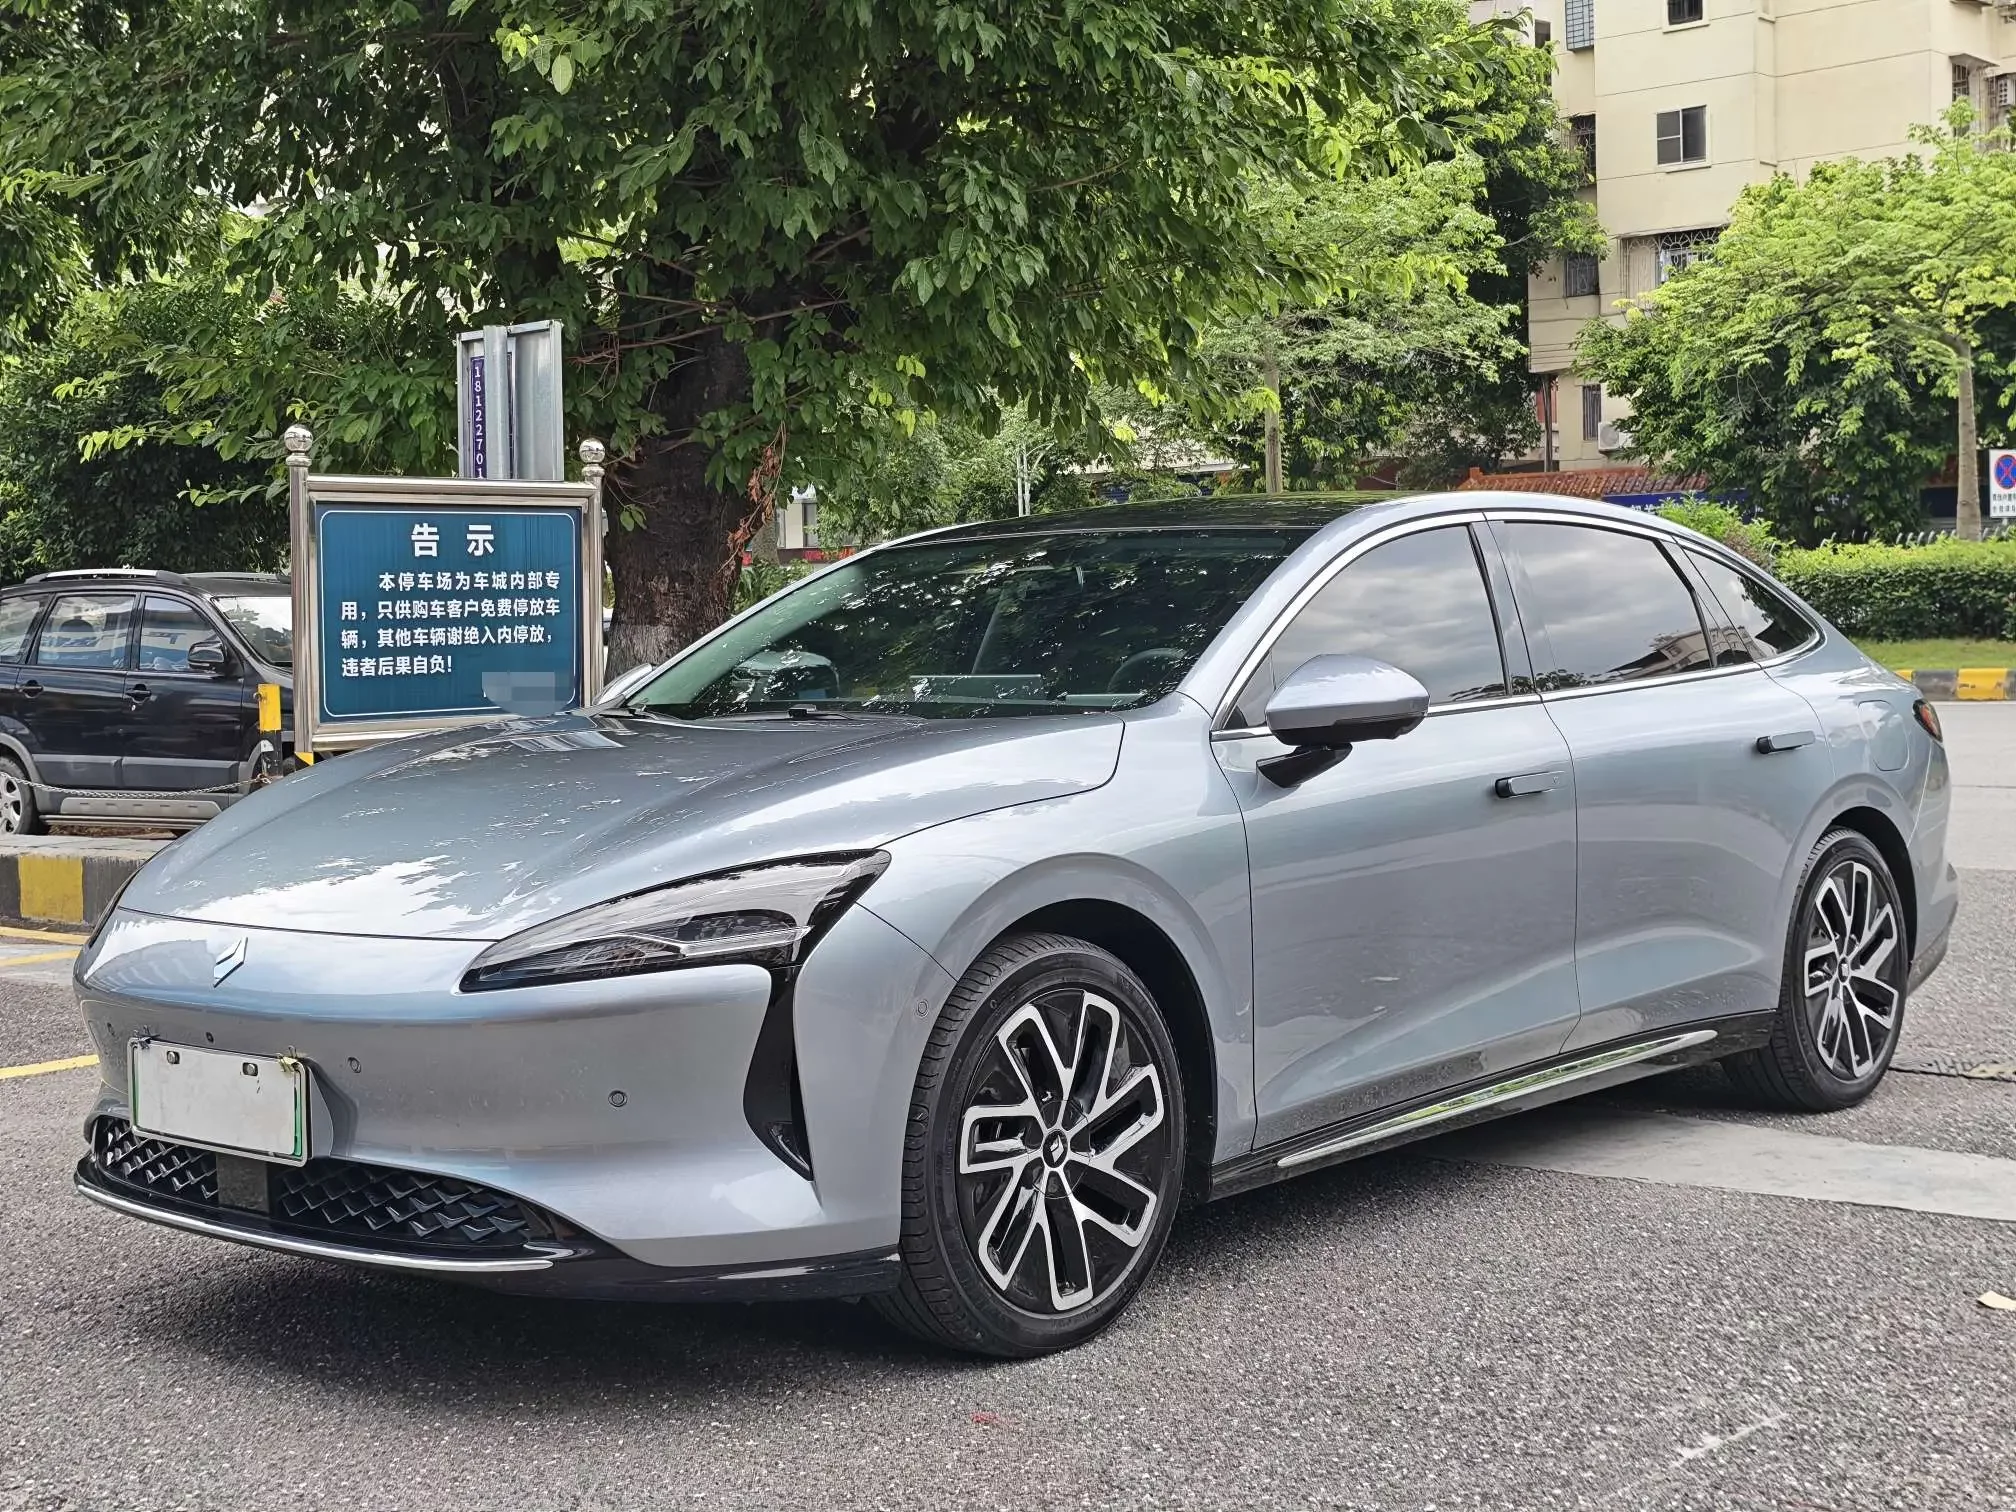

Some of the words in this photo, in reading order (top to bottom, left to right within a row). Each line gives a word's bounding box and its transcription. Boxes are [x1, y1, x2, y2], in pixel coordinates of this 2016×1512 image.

[411, 523, 495, 557] 告示
[378, 571, 561, 592] 本停车场为车城内部专
[341, 598, 561, 621] 用，只供购车客户免费停放车
[341, 624, 553, 649] 辆，其他车辆谢绝入内停放，
